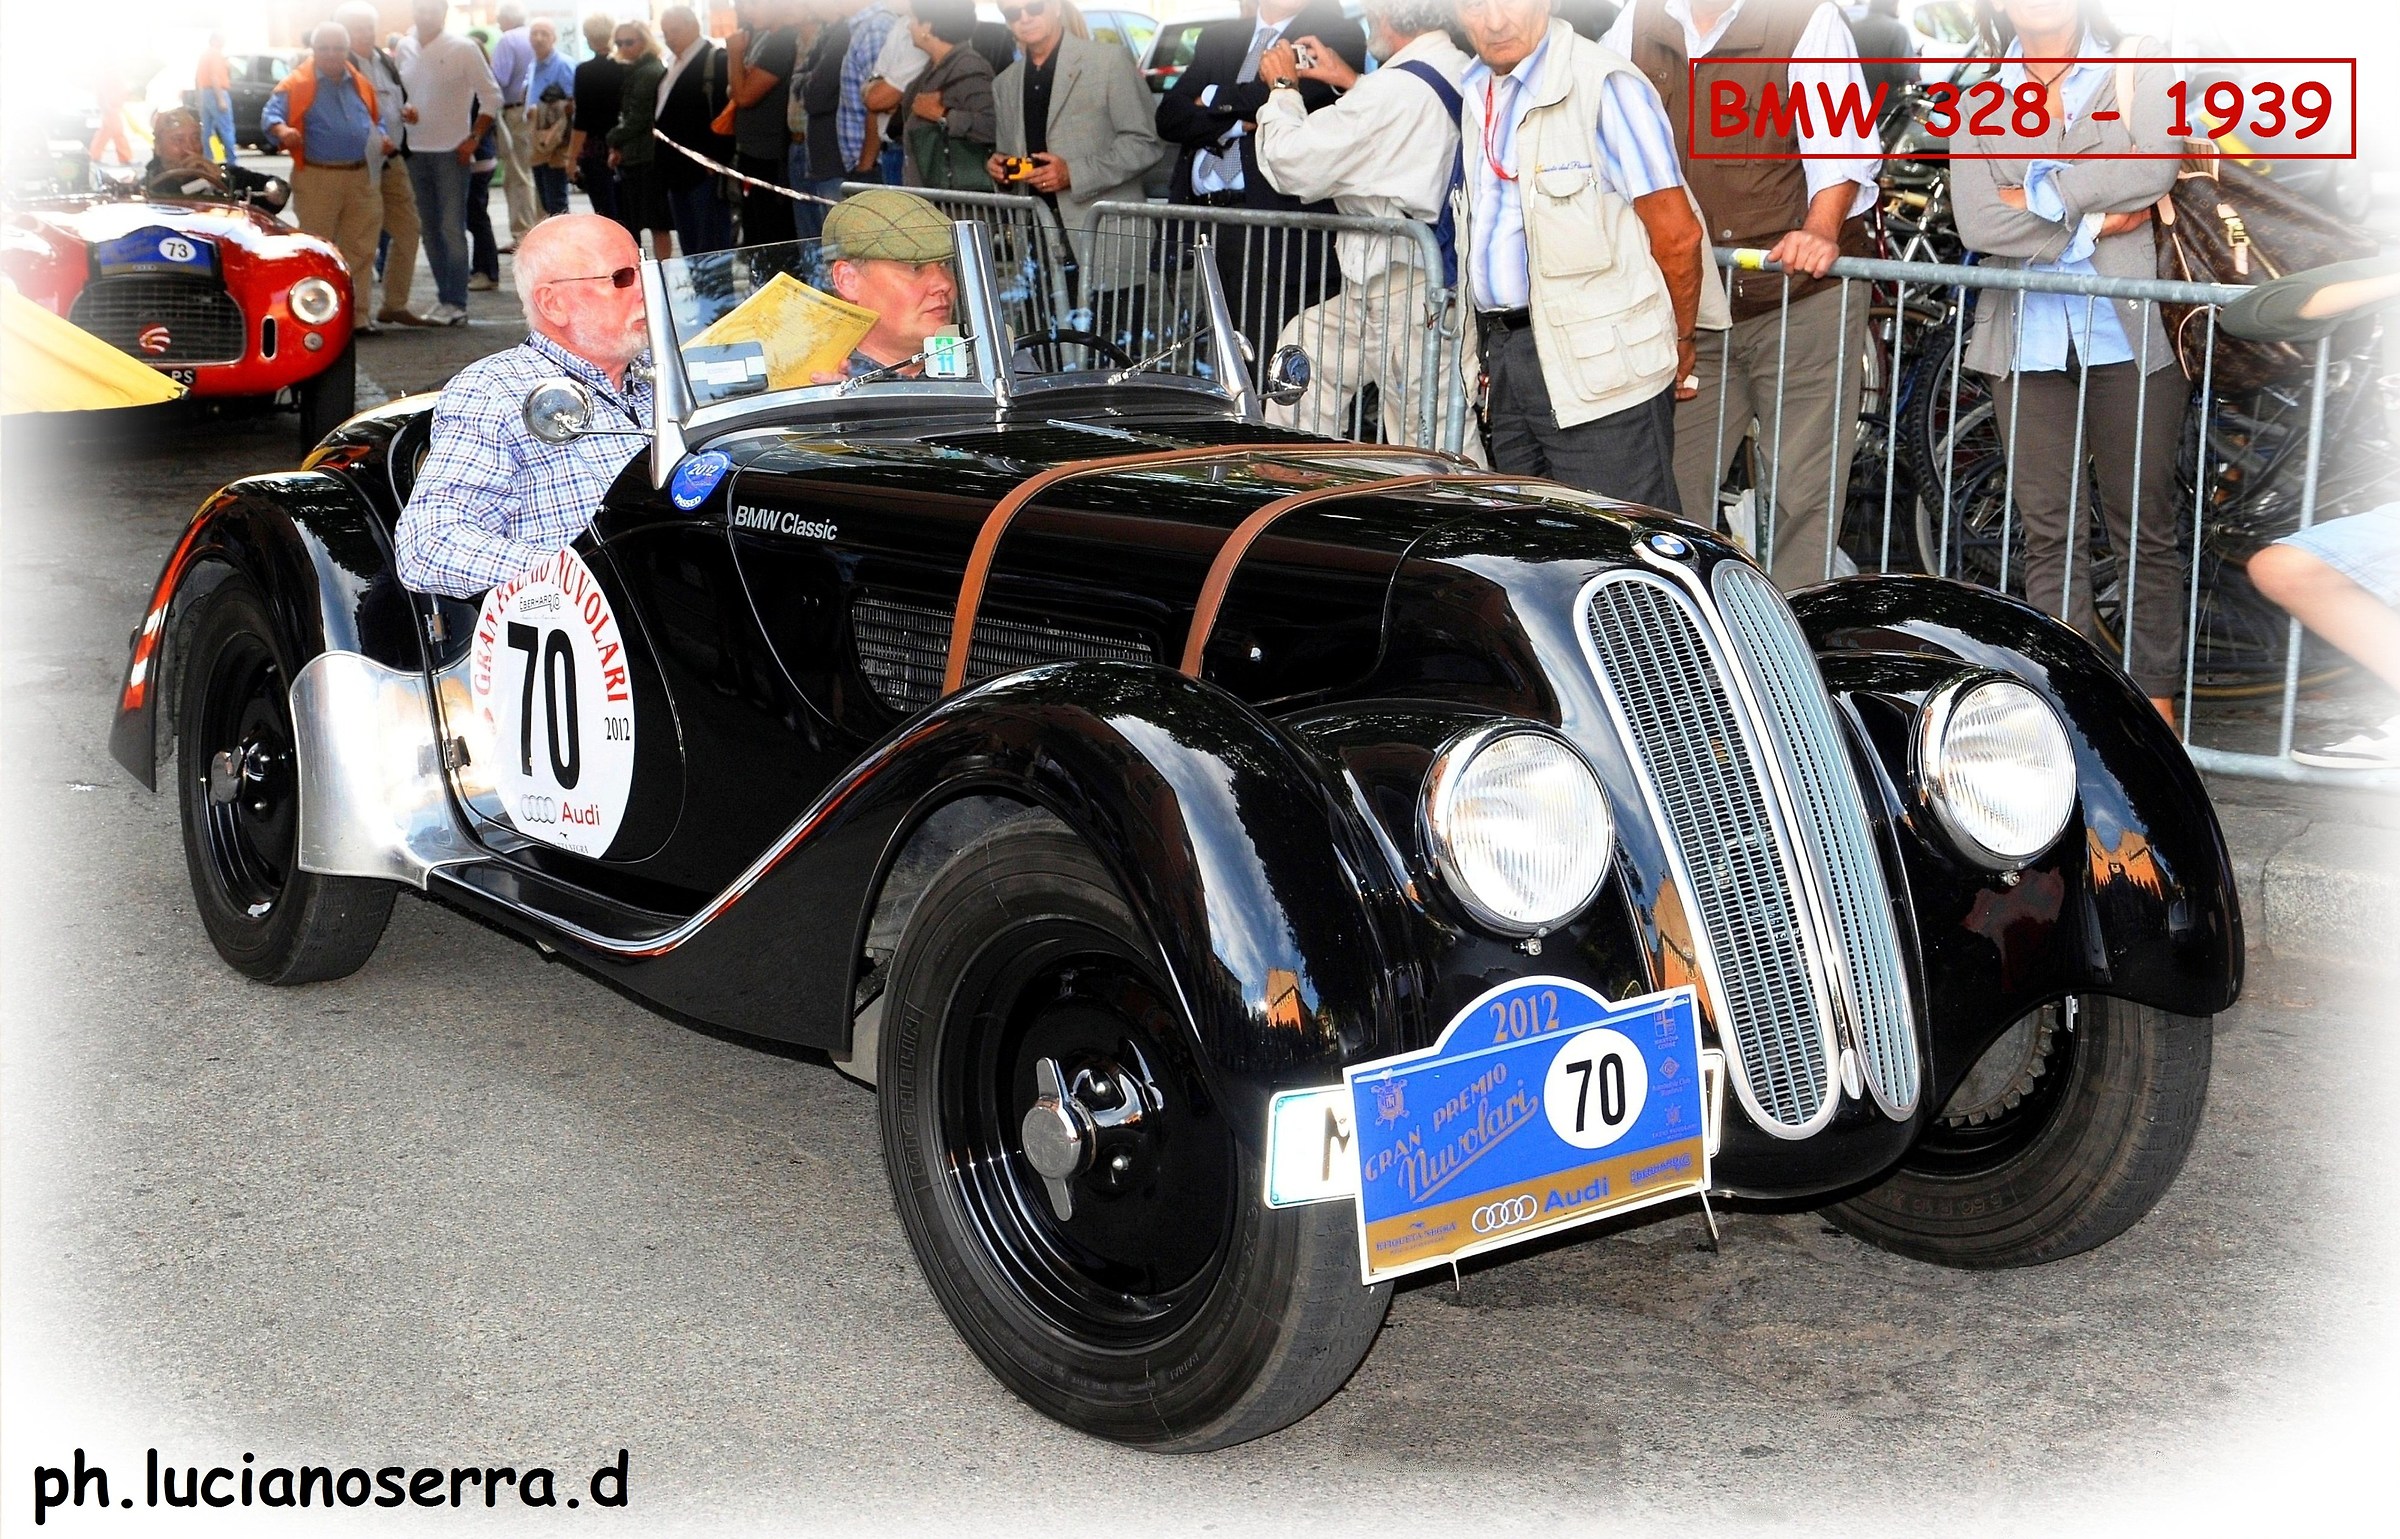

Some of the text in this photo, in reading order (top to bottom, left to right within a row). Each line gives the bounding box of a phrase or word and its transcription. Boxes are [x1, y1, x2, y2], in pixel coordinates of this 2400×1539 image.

[166, 242, 189, 259] 73
[937, 355, 955, 372] 11
[687, 463, 720, 477] 2012
[674, 493, 702, 508] PASSED
[735, 505, 838, 541] BMW Classic
[474, 607, 499, 696] GRAN
[551, 550, 629, 703] NUVOLARI
[507, 620, 581, 791] 70
[604, 717, 631, 741] 2012
[562, 801, 600, 826] Audi
[1489, 990, 1562, 1045] 2012
[898, 1015, 926, 1178] MICHELIN
[1565, 1052, 1627, 1133] 70
[1365, 1062, 1508, 1182] GRAN PREMIO
[1398, 1079, 1539, 1201] Nuvolari
[1544, 1177, 1610, 1213] Audi
